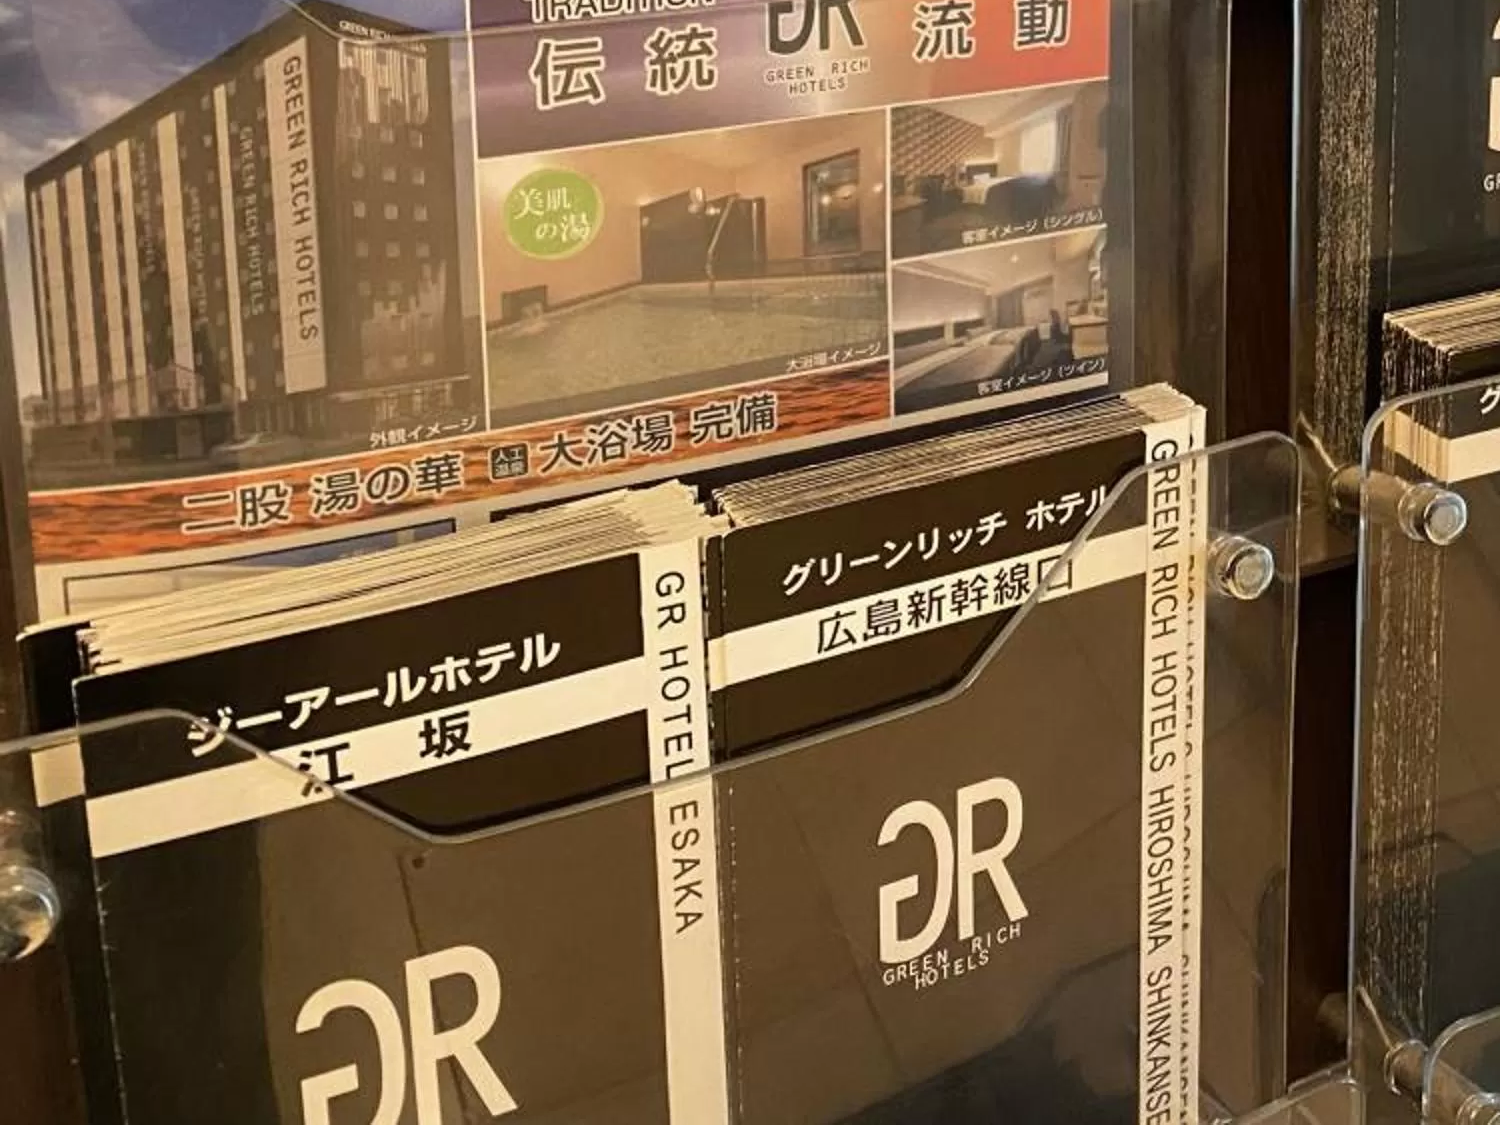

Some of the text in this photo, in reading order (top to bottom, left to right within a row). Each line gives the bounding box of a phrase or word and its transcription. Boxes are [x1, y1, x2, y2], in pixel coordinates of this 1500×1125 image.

[767, 59, 868, 83] GREEN RICH
[788, 76, 847, 96] HOTELS
[283, 56, 319, 341] GREEN RICH HOTELS
[513, 186, 571, 216] 美肌
[534, 213, 591, 245] の湯
[183, 482, 293, 536] 二股
[310, 452, 464, 518] 湯の華
[539, 414, 674, 474] 大浴場
[690, 394, 777, 444] 完備
[370, 416, 479, 449] 外観イメージ
[782, 485, 1110, 596] グリーンリッチ ホテル
[1151, 438, 1180, 551] GREEN
[816, 554, 1074, 655] 広島新幹線口
[1151, 565, 1179, 642] RICH
[187, 632, 561, 757] ジーアールホテル
[1149, 653, 1179, 770] HOTELS
[654, 571, 704, 935] GR HOTEL ESAKA
[1147, 784, 1177, 955] HIROSHIMA
[882, 921, 1022, 986] GREEN RICH
[914, 949, 991, 991] HOTELS
